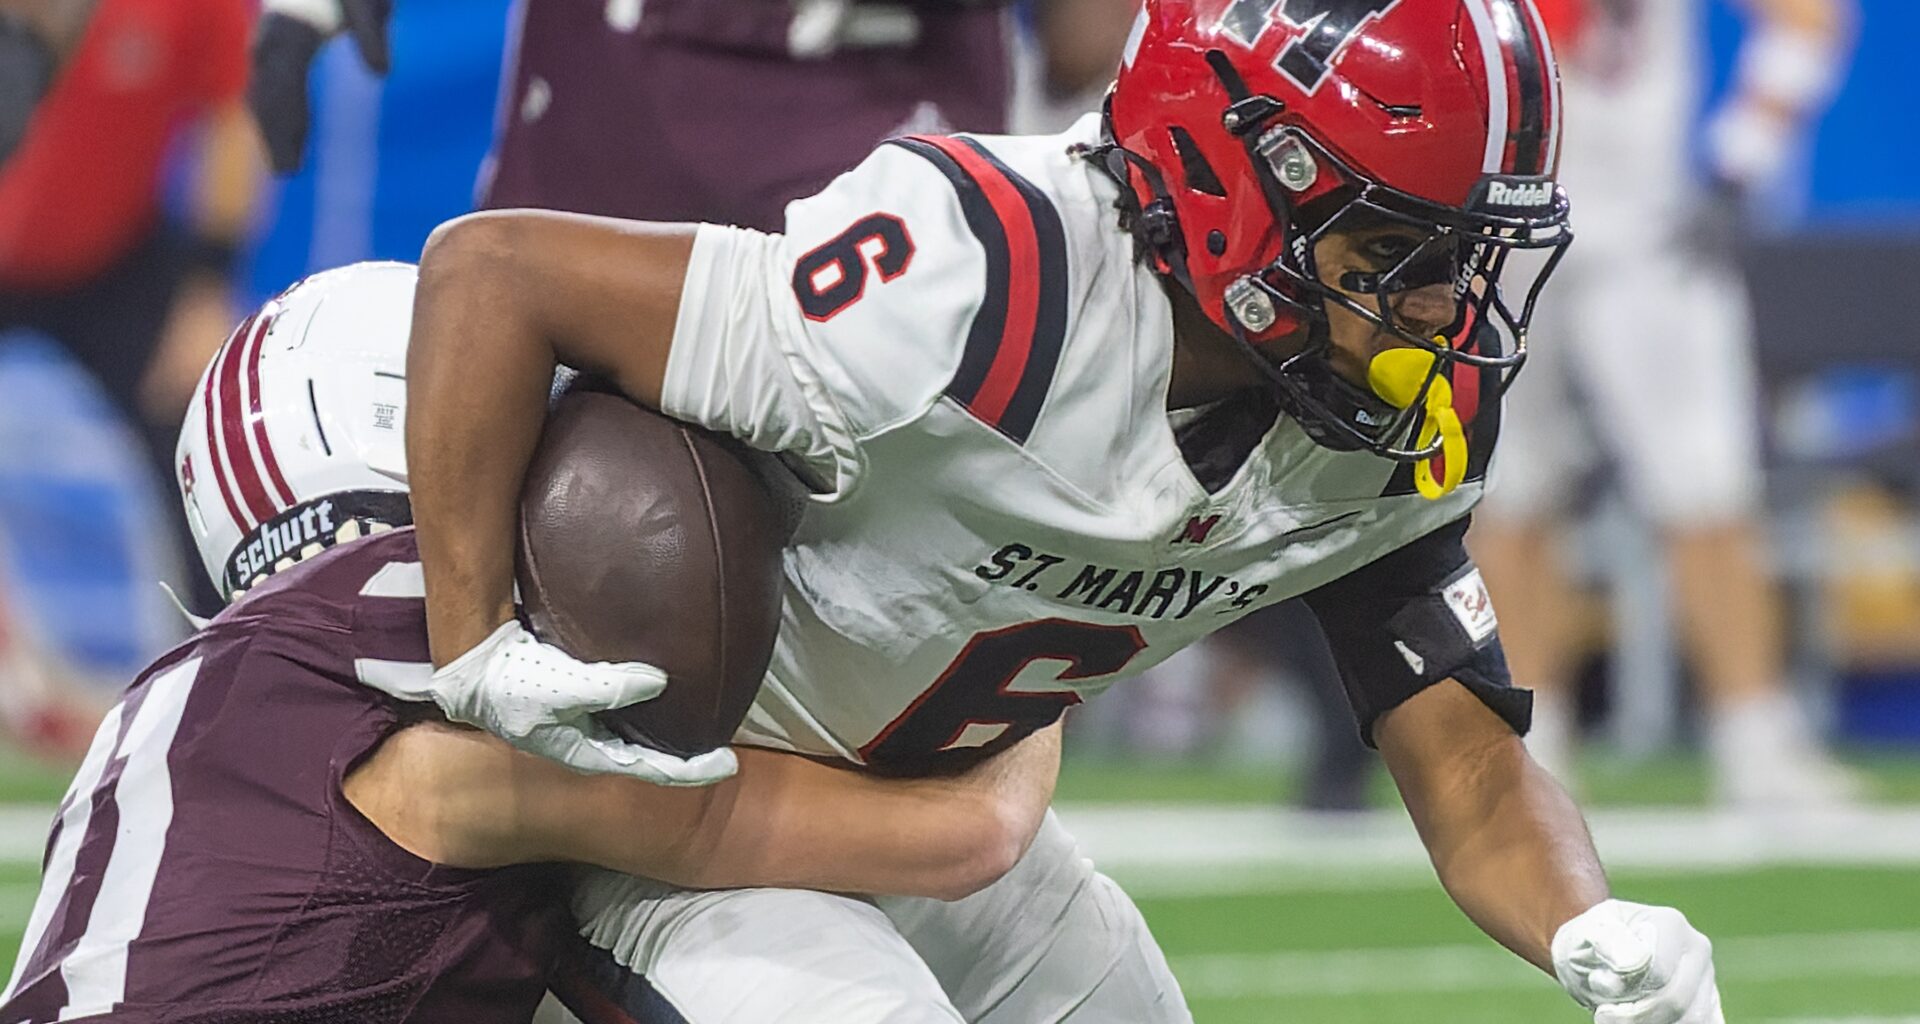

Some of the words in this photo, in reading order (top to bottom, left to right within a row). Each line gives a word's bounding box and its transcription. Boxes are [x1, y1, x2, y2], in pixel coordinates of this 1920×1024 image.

[1486, 181, 1554, 207] Riddell
[792, 212, 916, 323] 6
[235, 499, 335, 586] schutt
[975, 543, 1065, 592] ST.
[857, 616, 1149, 777] 6
